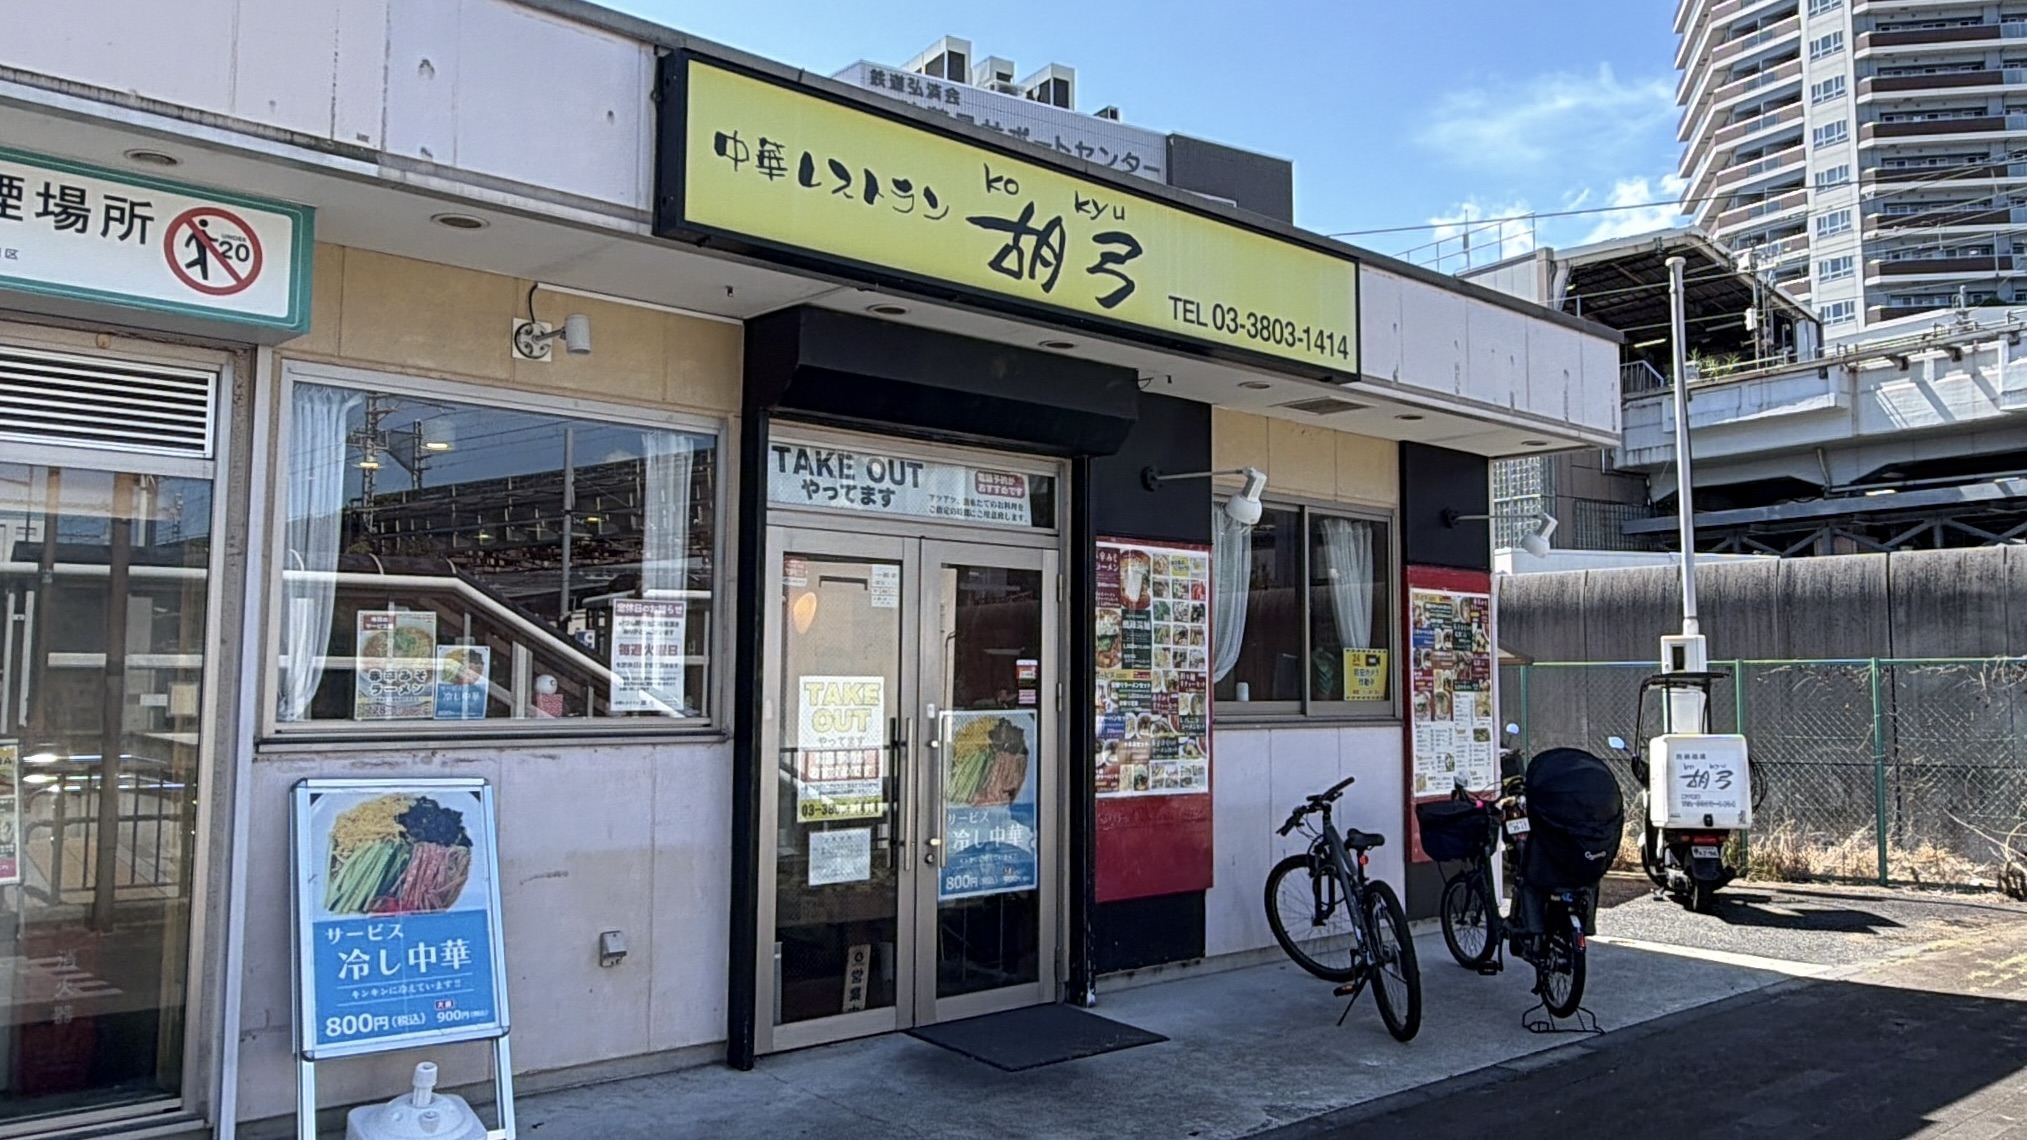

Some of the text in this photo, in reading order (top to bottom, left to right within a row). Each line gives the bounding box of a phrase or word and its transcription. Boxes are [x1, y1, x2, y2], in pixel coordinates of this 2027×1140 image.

[1074, 190, 1126, 221] kyu
[218, 240, 250, 262] 20
[965, 200, 1143, 308] 胡弓
[1168, 295, 1349, 360] TEL 03-3803-1414
[771, 445, 924, 488] TAKE OUT
[801, 478, 896, 508] やってます
[371, 684, 425, 696] ラーメン
[804, 682, 881, 706] TAKE
[812, 708, 871, 733] OUT
[1679, 768, 1734, 790] 胡弓
[952, 823, 1023, 851] 冷し中華
[325, 923, 404, 944] サービス
[337, 938, 472, 980] 冷し中華
